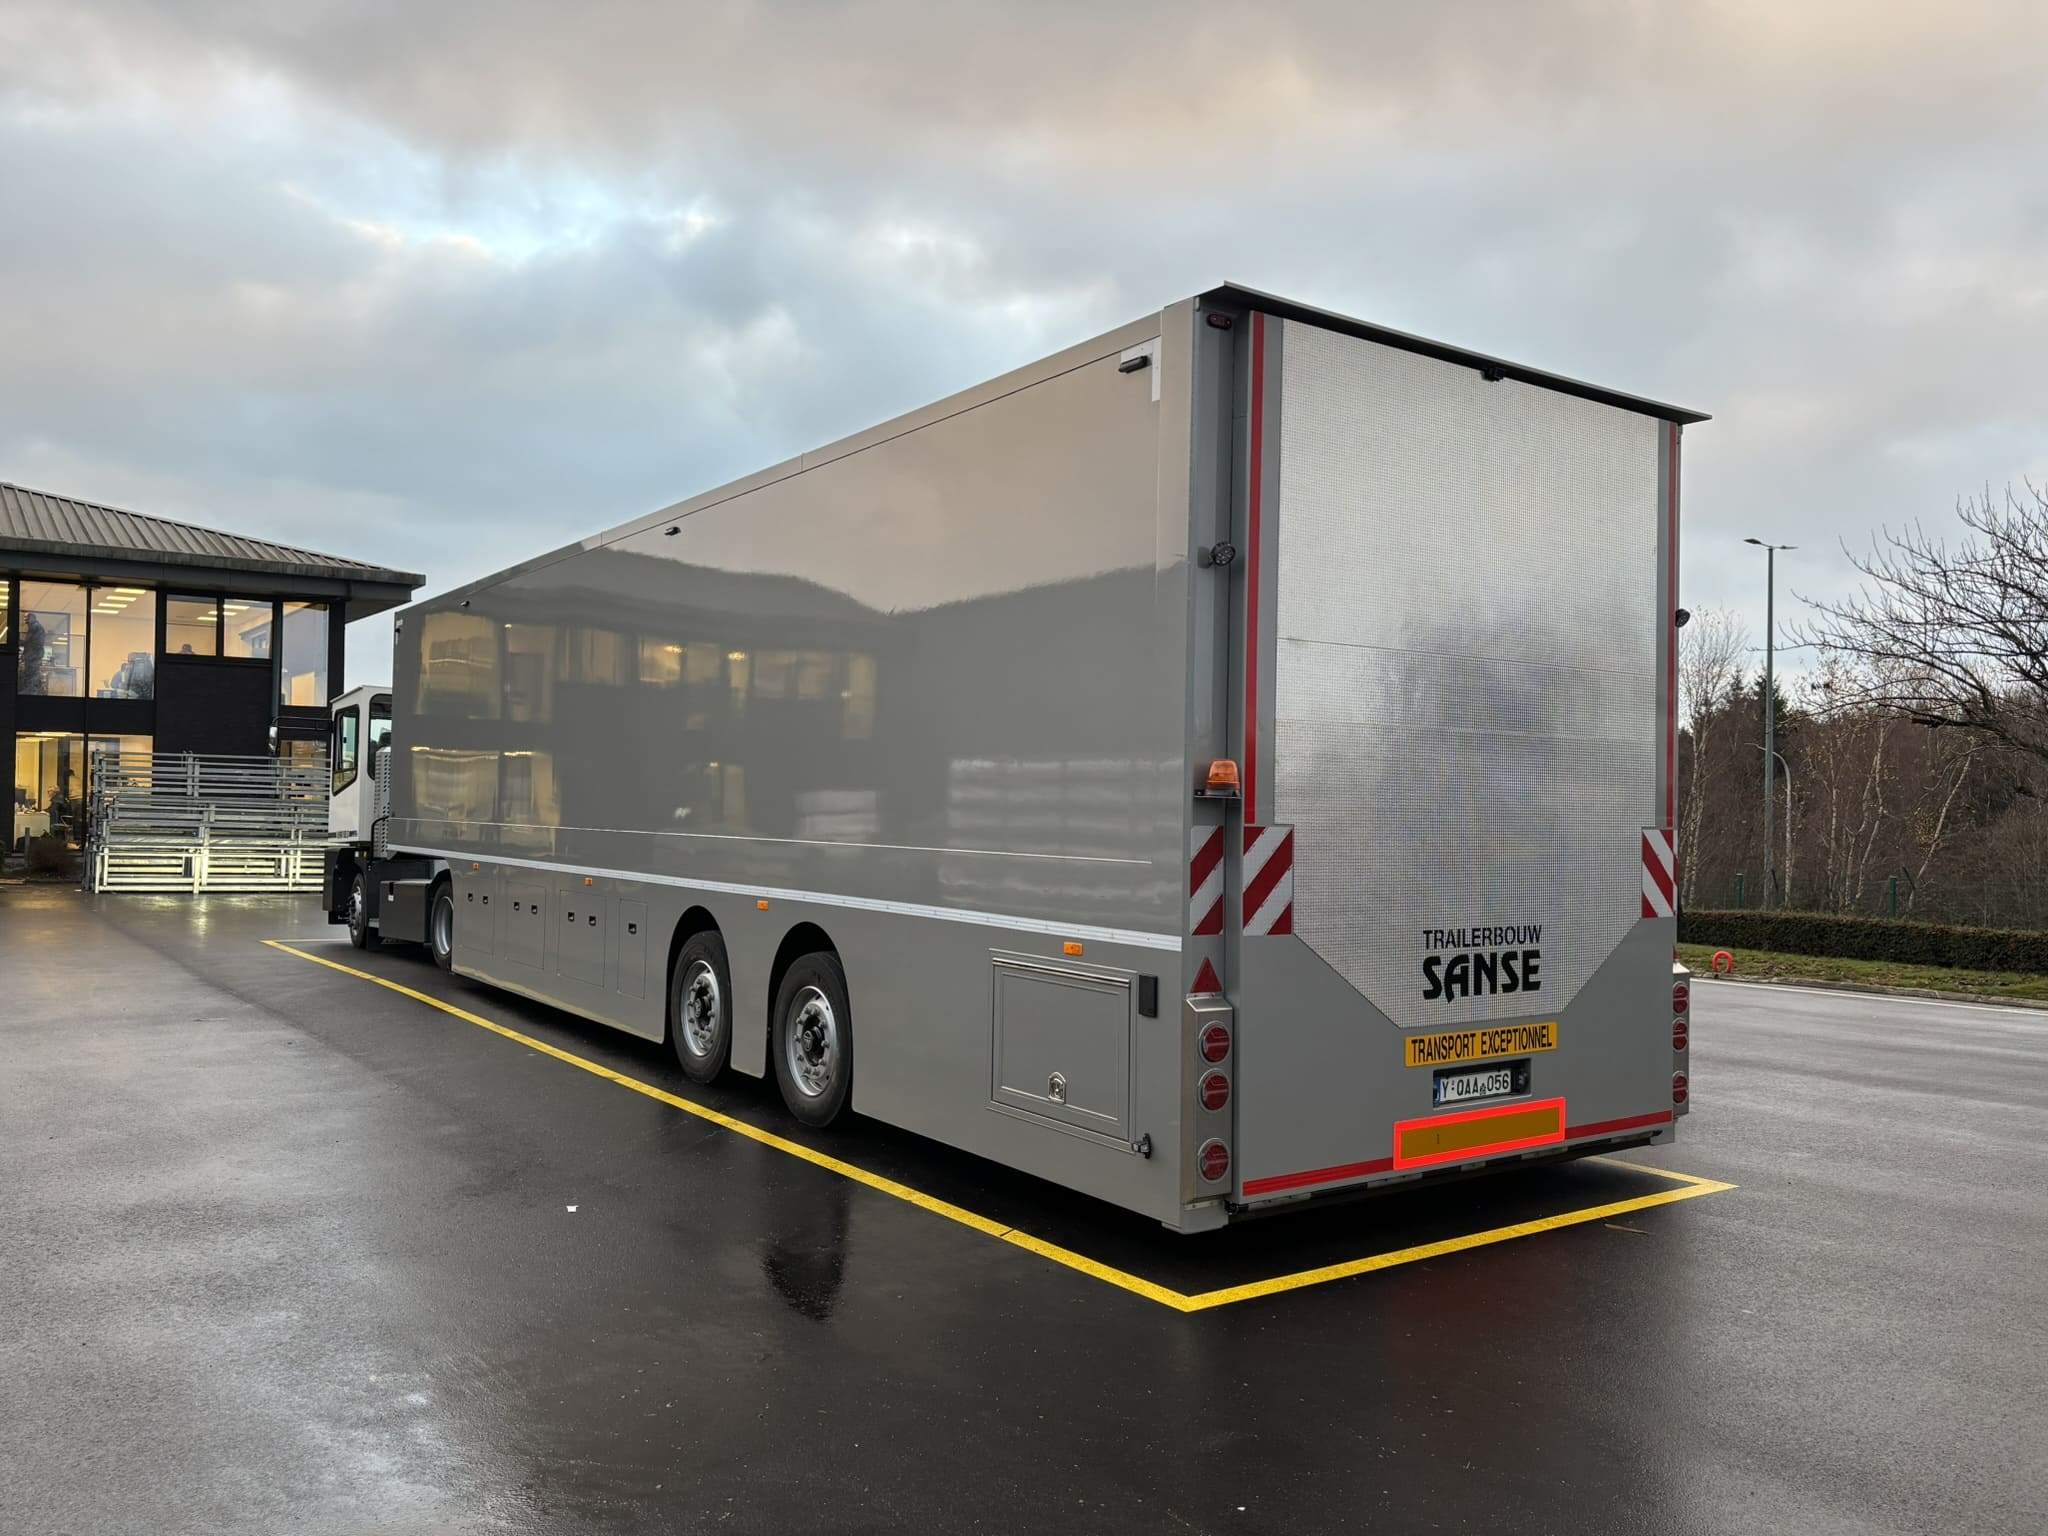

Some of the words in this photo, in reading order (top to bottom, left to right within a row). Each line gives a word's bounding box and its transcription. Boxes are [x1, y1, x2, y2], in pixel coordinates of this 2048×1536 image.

[1423, 925, 1542, 949] TRAILERBOUW
[1423, 949, 1541, 1003] SANSE
[1411, 1034, 1476, 1063] TRANSPORT
[1480, 1025, 1552, 1054] EXCEPTIONNEL
